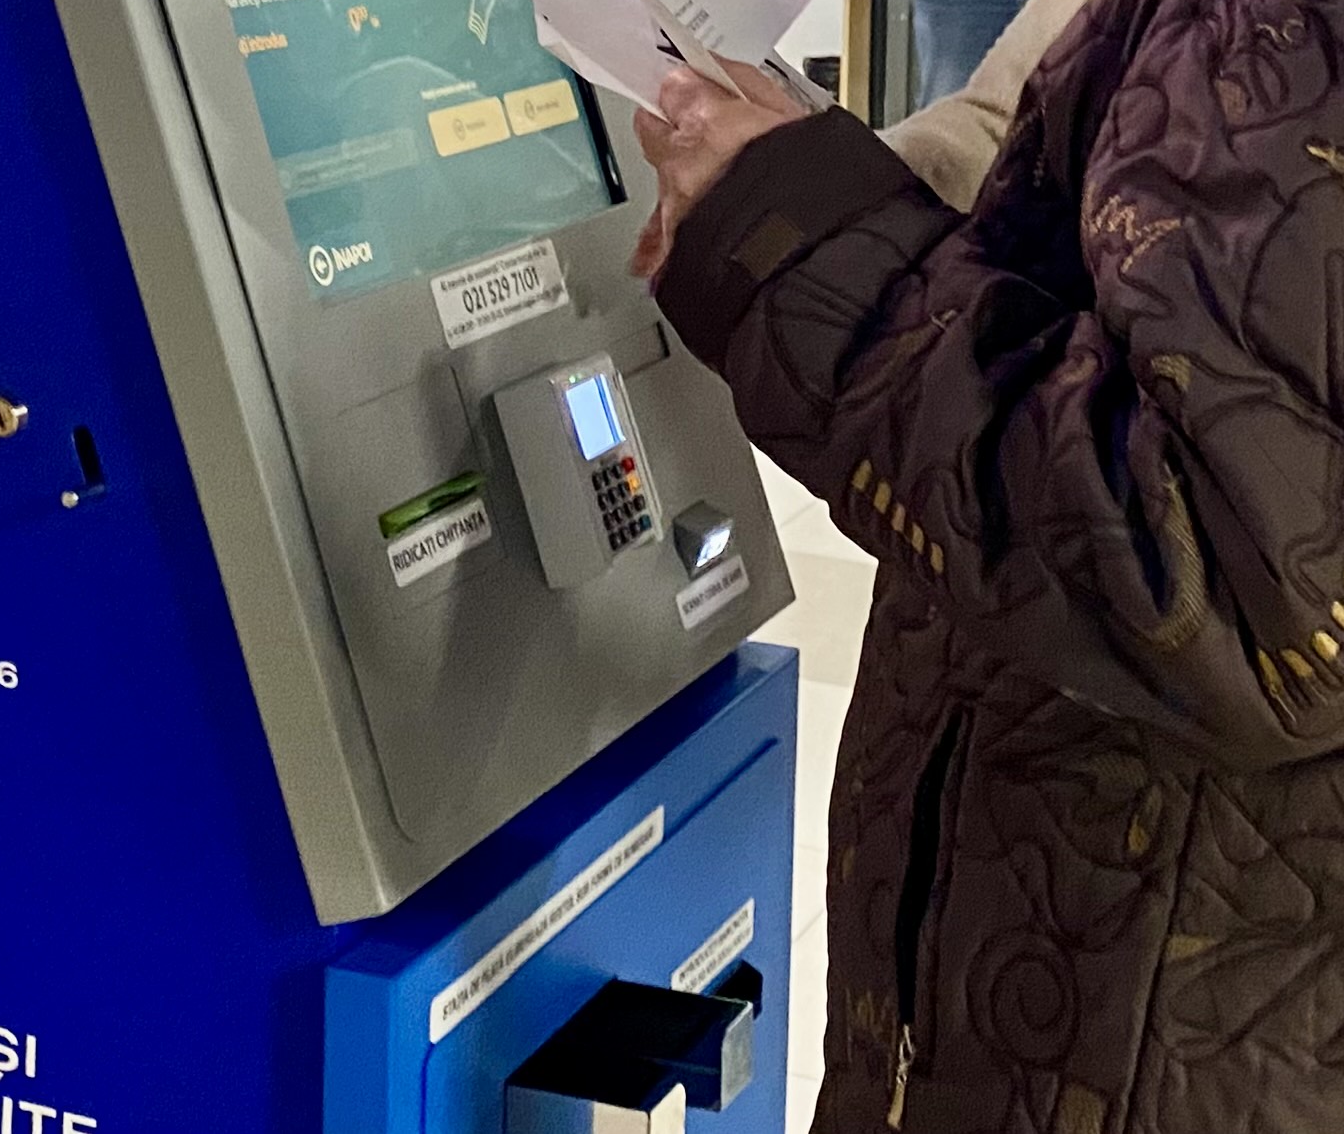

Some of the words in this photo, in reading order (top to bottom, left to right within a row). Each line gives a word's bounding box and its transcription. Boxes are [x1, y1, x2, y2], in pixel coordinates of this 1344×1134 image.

[462, 284, 489, 315] 021
[486, 275, 512, 305] 529
[511, 266, 541, 297] 7101
